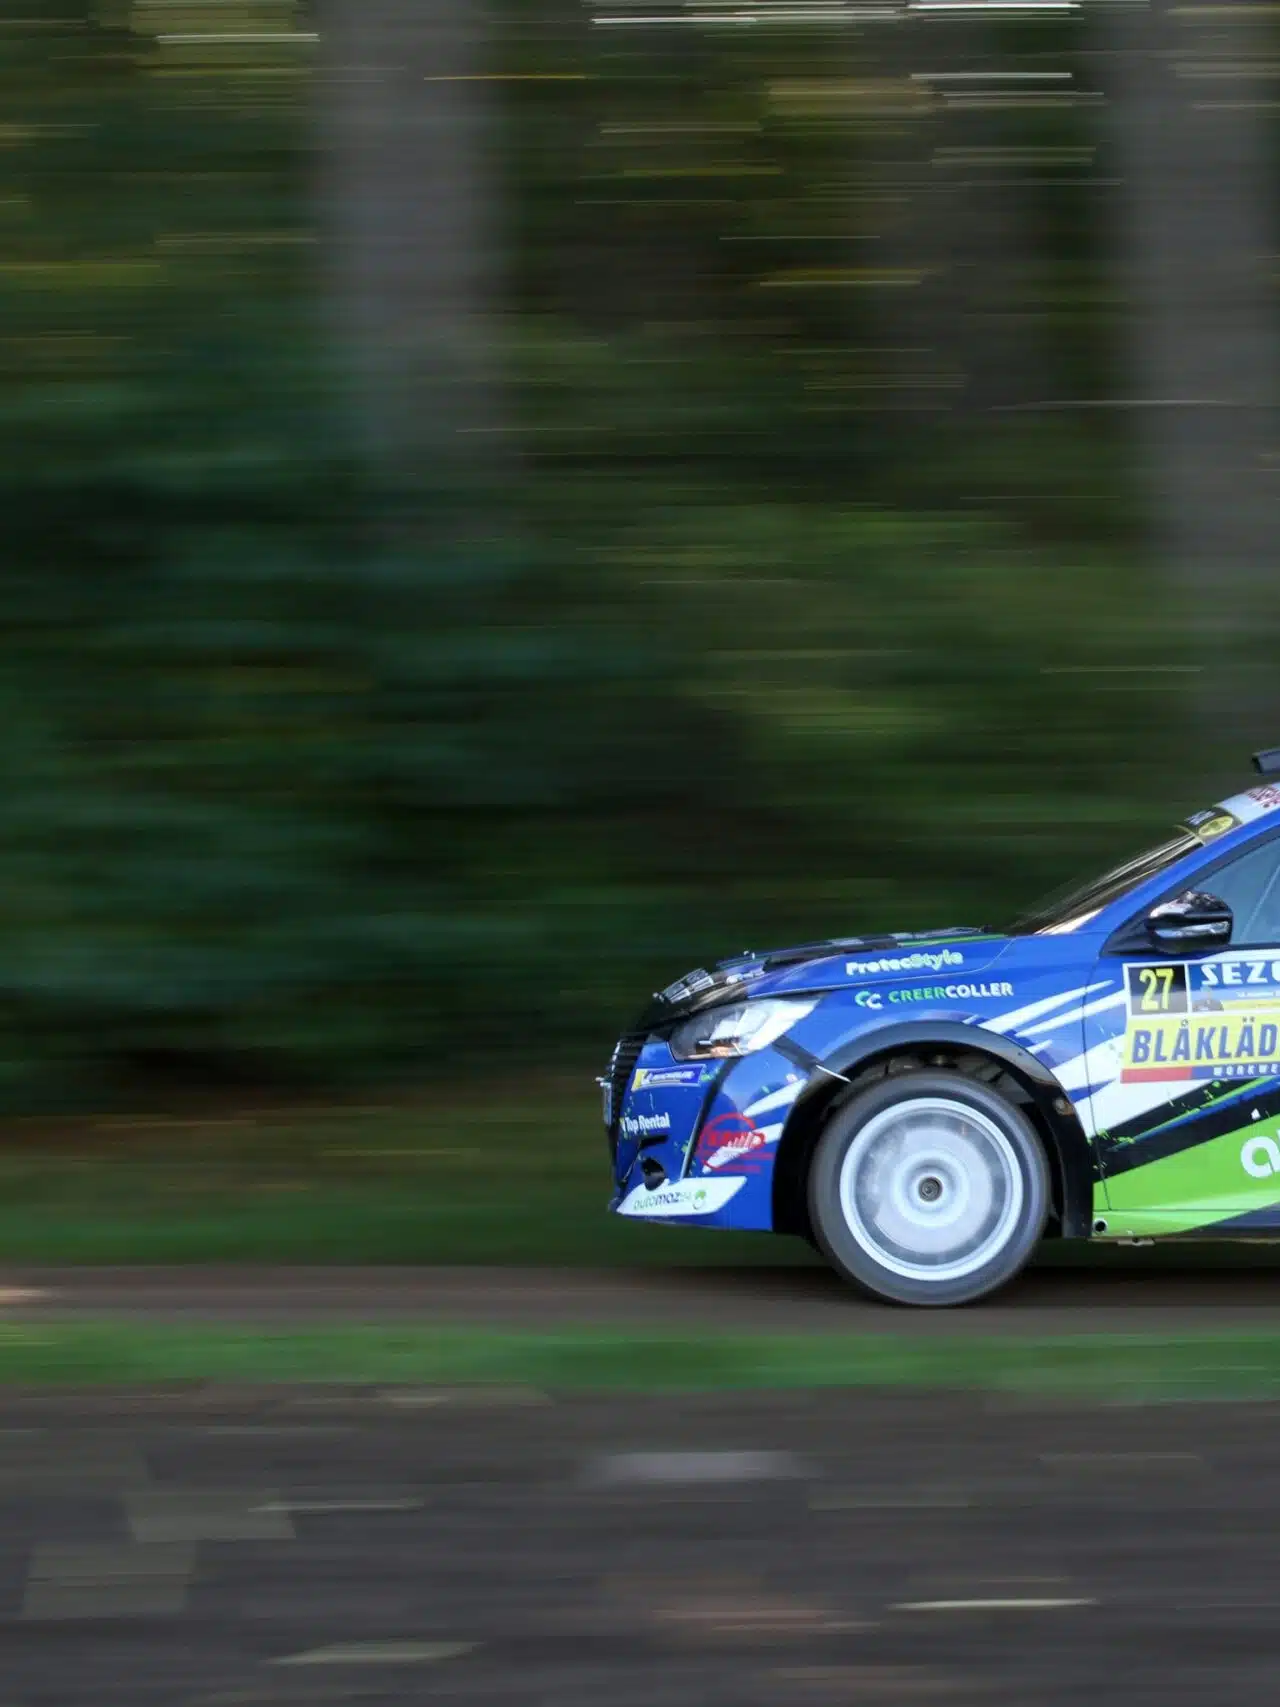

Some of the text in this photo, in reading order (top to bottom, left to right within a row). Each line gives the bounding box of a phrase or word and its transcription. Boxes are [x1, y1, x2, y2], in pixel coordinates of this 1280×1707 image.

[845, 949, 964, 976] ProtecStyle
[888, 982, 1014, 1004] CREERCOLLER
[1139, 967, 1174, 1011] 27
